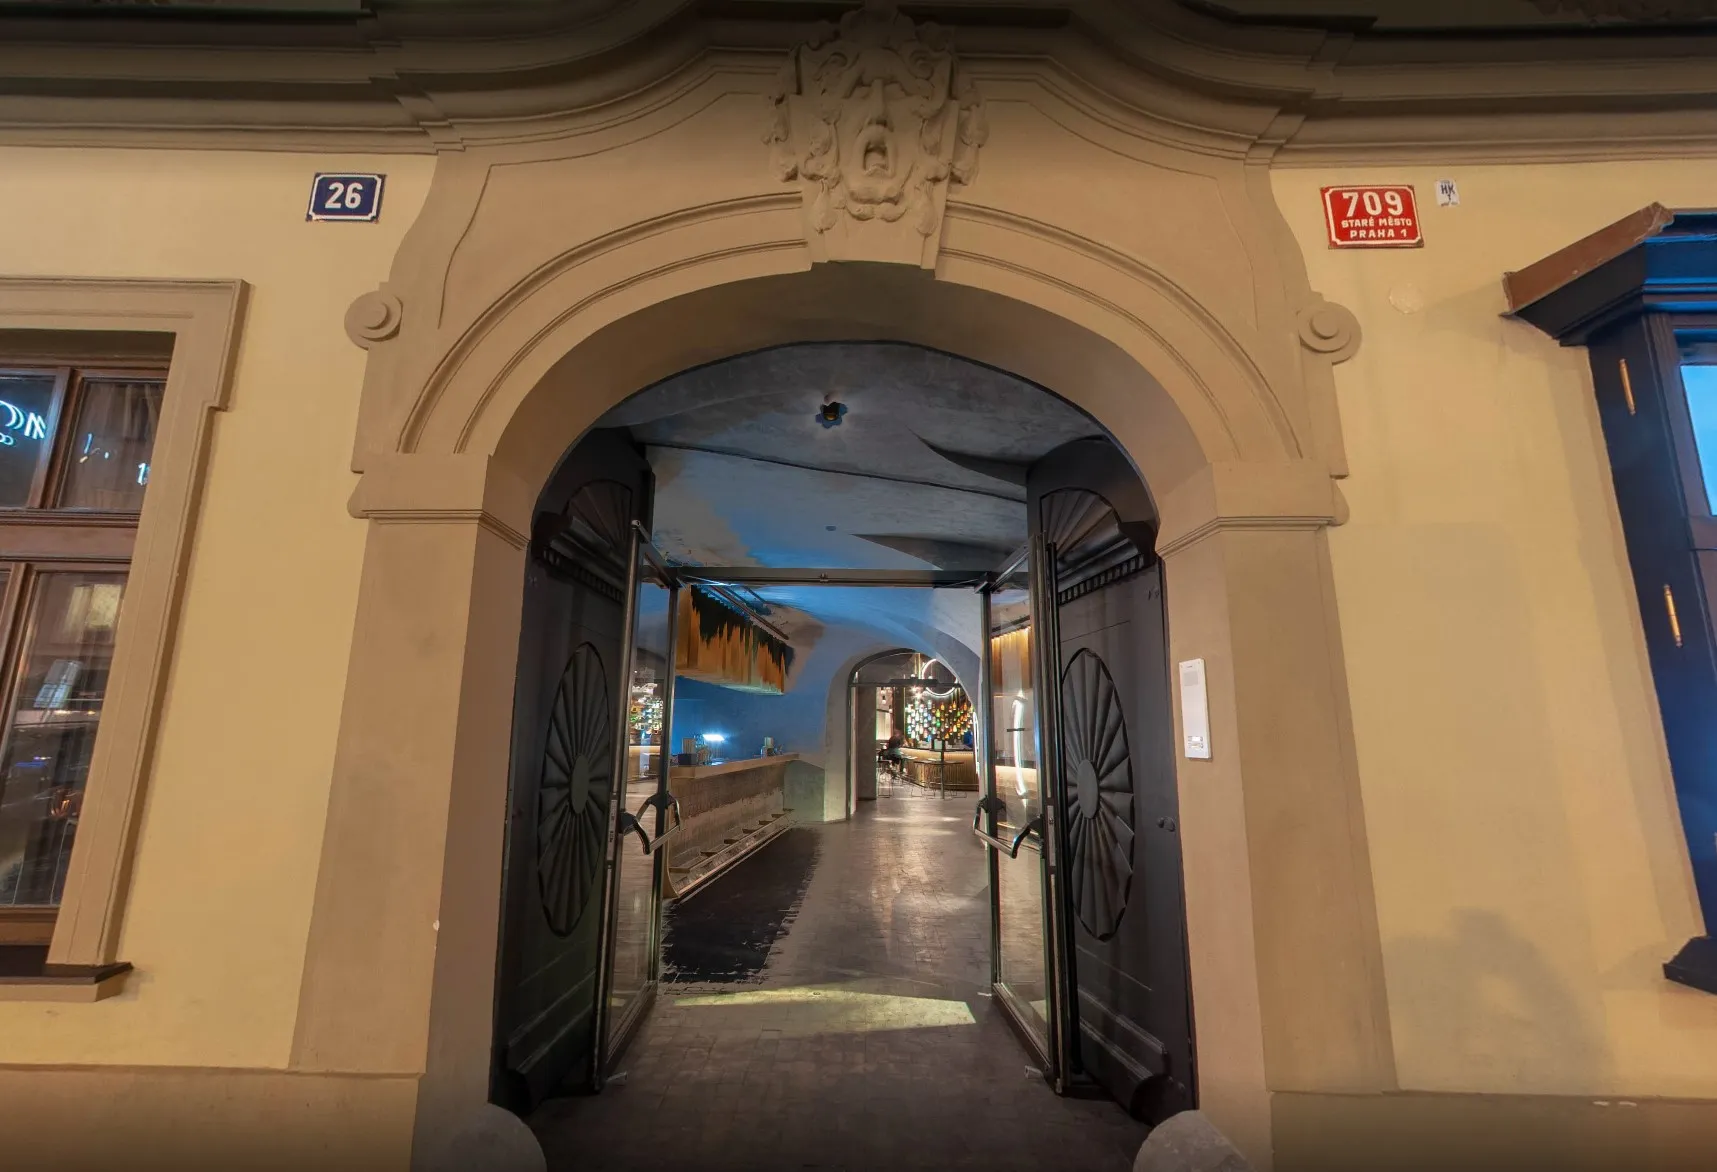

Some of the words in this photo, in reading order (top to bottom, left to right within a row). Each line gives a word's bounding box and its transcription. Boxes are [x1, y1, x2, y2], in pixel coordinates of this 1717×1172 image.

[324, 182, 363, 209] 26
[1342, 191, 1403, 217] 709
[1341, 217, 1375, 228] STARÉ
[1378, 216, 1412, 227] MĚSTO
[1350, 229, 1395, 239] PRAHA
[1400, 229, 1408, 238] 1
